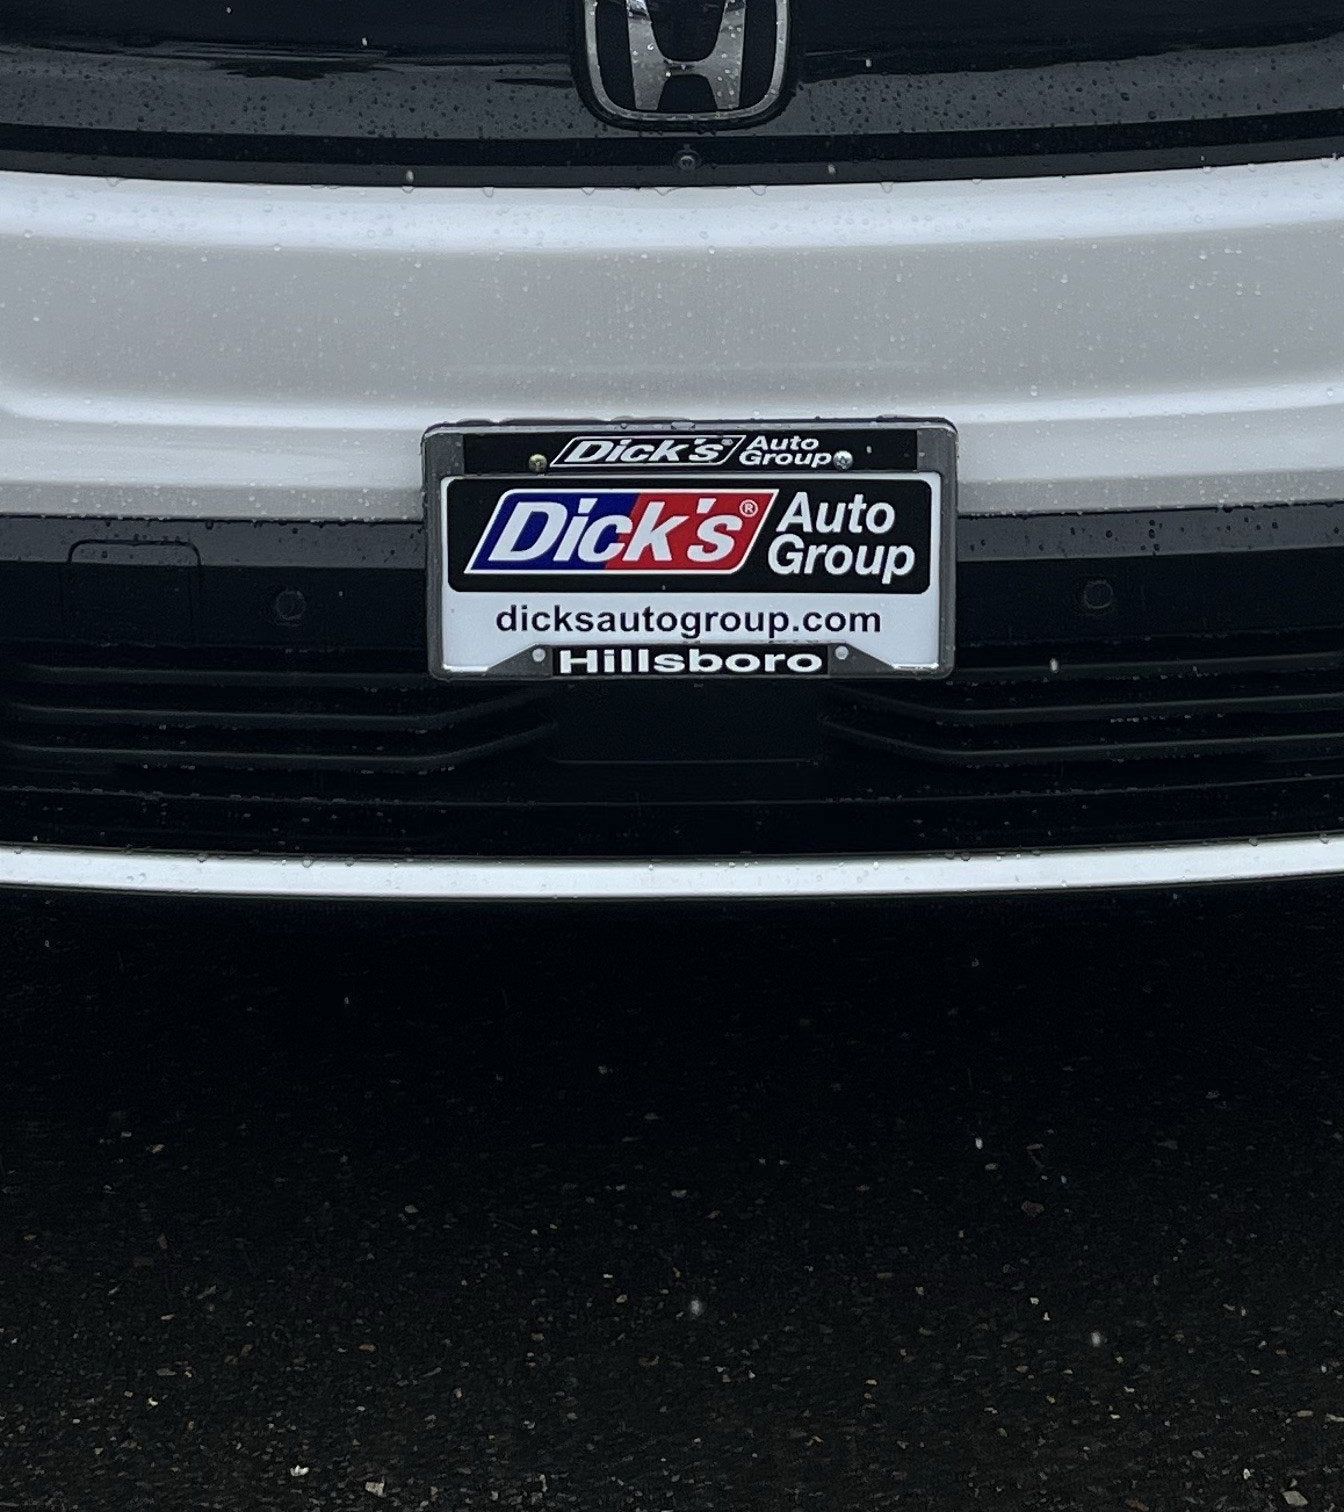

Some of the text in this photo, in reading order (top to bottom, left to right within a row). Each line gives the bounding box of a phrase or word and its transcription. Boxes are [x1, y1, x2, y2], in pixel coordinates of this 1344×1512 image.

[745, 435, 819, 451] Auto
[739, 450, 832, 468] Group
[775, 491, 896, 535] Auto
[767, 534, 916, 584] Group
[495, 604, 882, 639] dicksautogroup.com
[559, 648, 824, 674] Hillsboro
